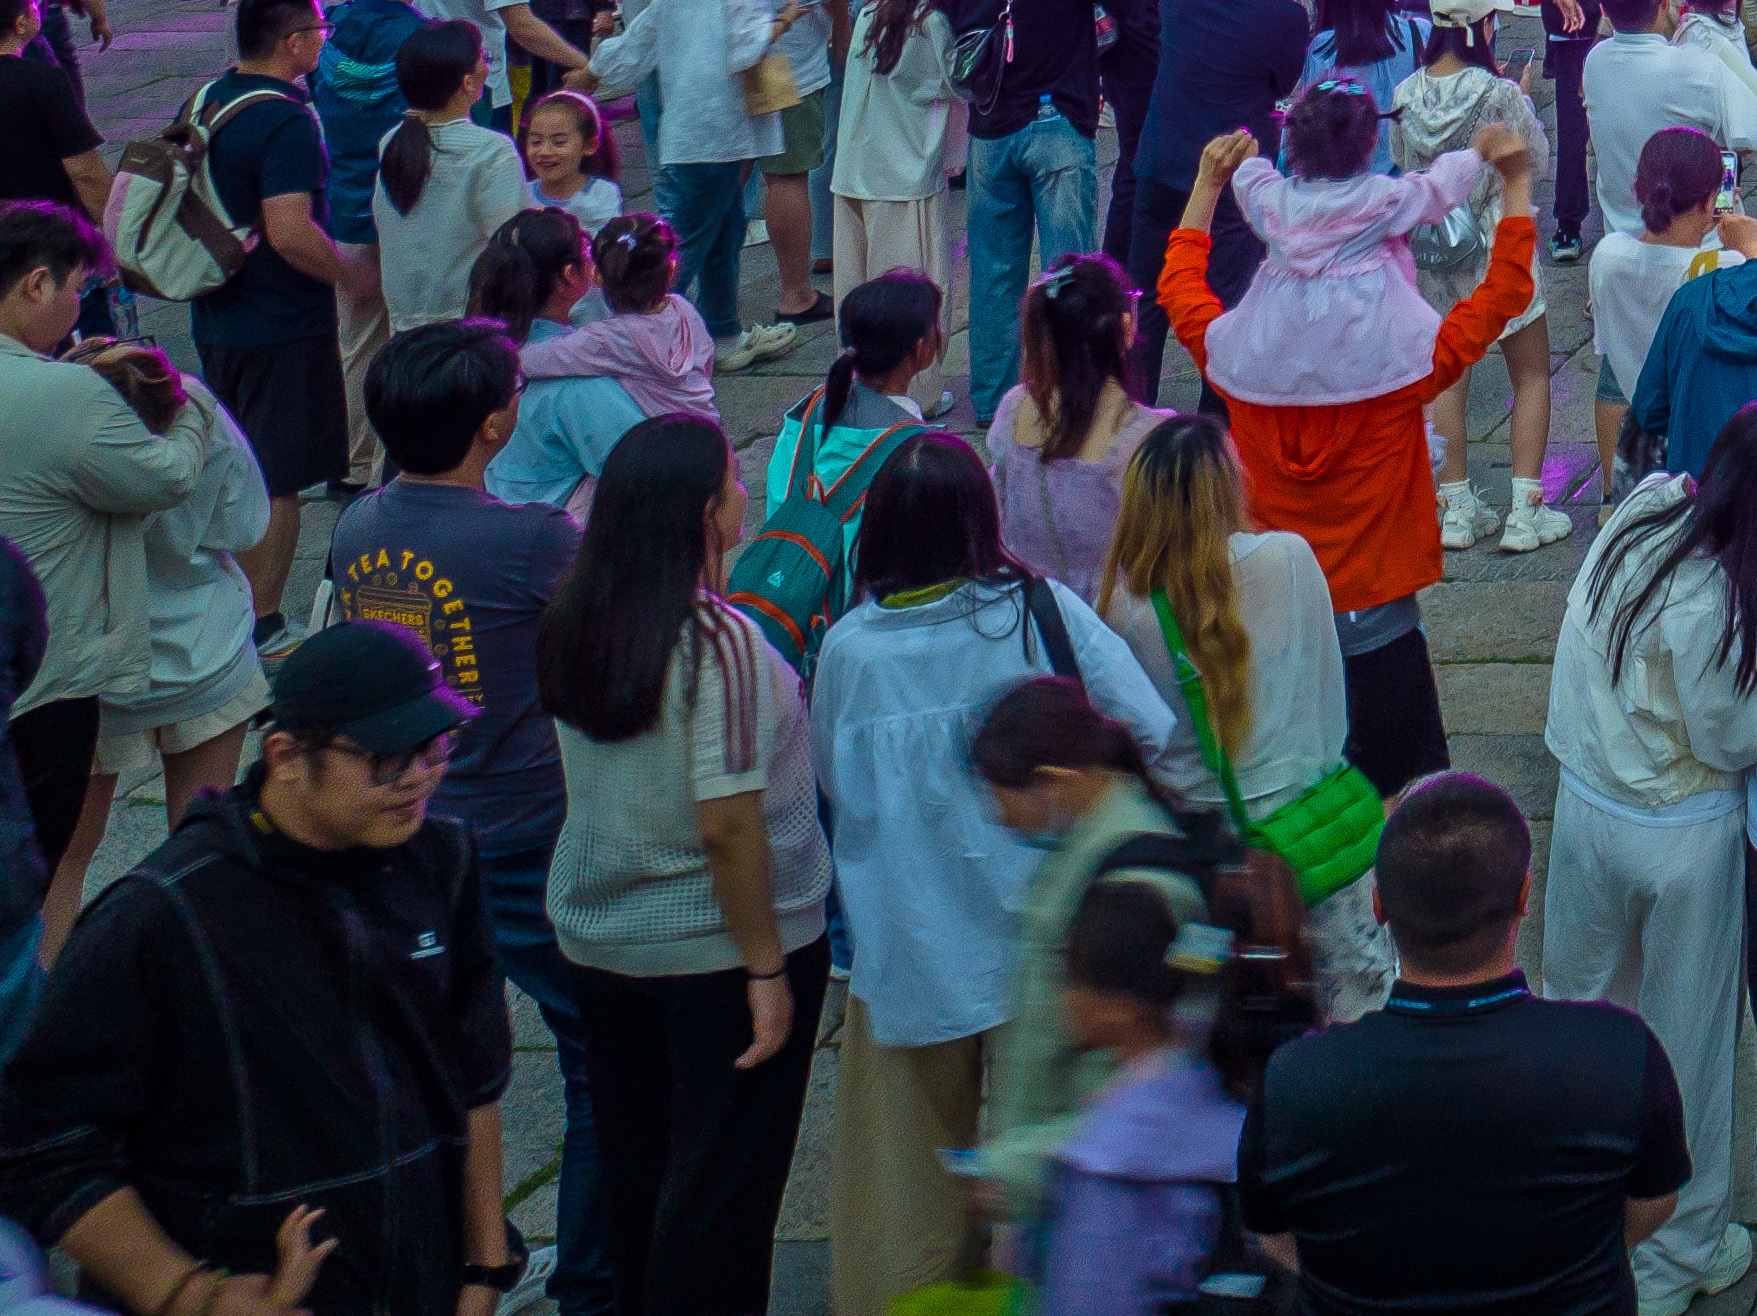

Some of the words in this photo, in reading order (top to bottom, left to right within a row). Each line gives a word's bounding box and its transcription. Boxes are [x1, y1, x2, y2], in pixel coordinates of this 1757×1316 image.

[347, 548, 391, 582] TEA
[401, 549, 479, 684] TOGETHER
[362, 608, 424, 626] SKECHERS
